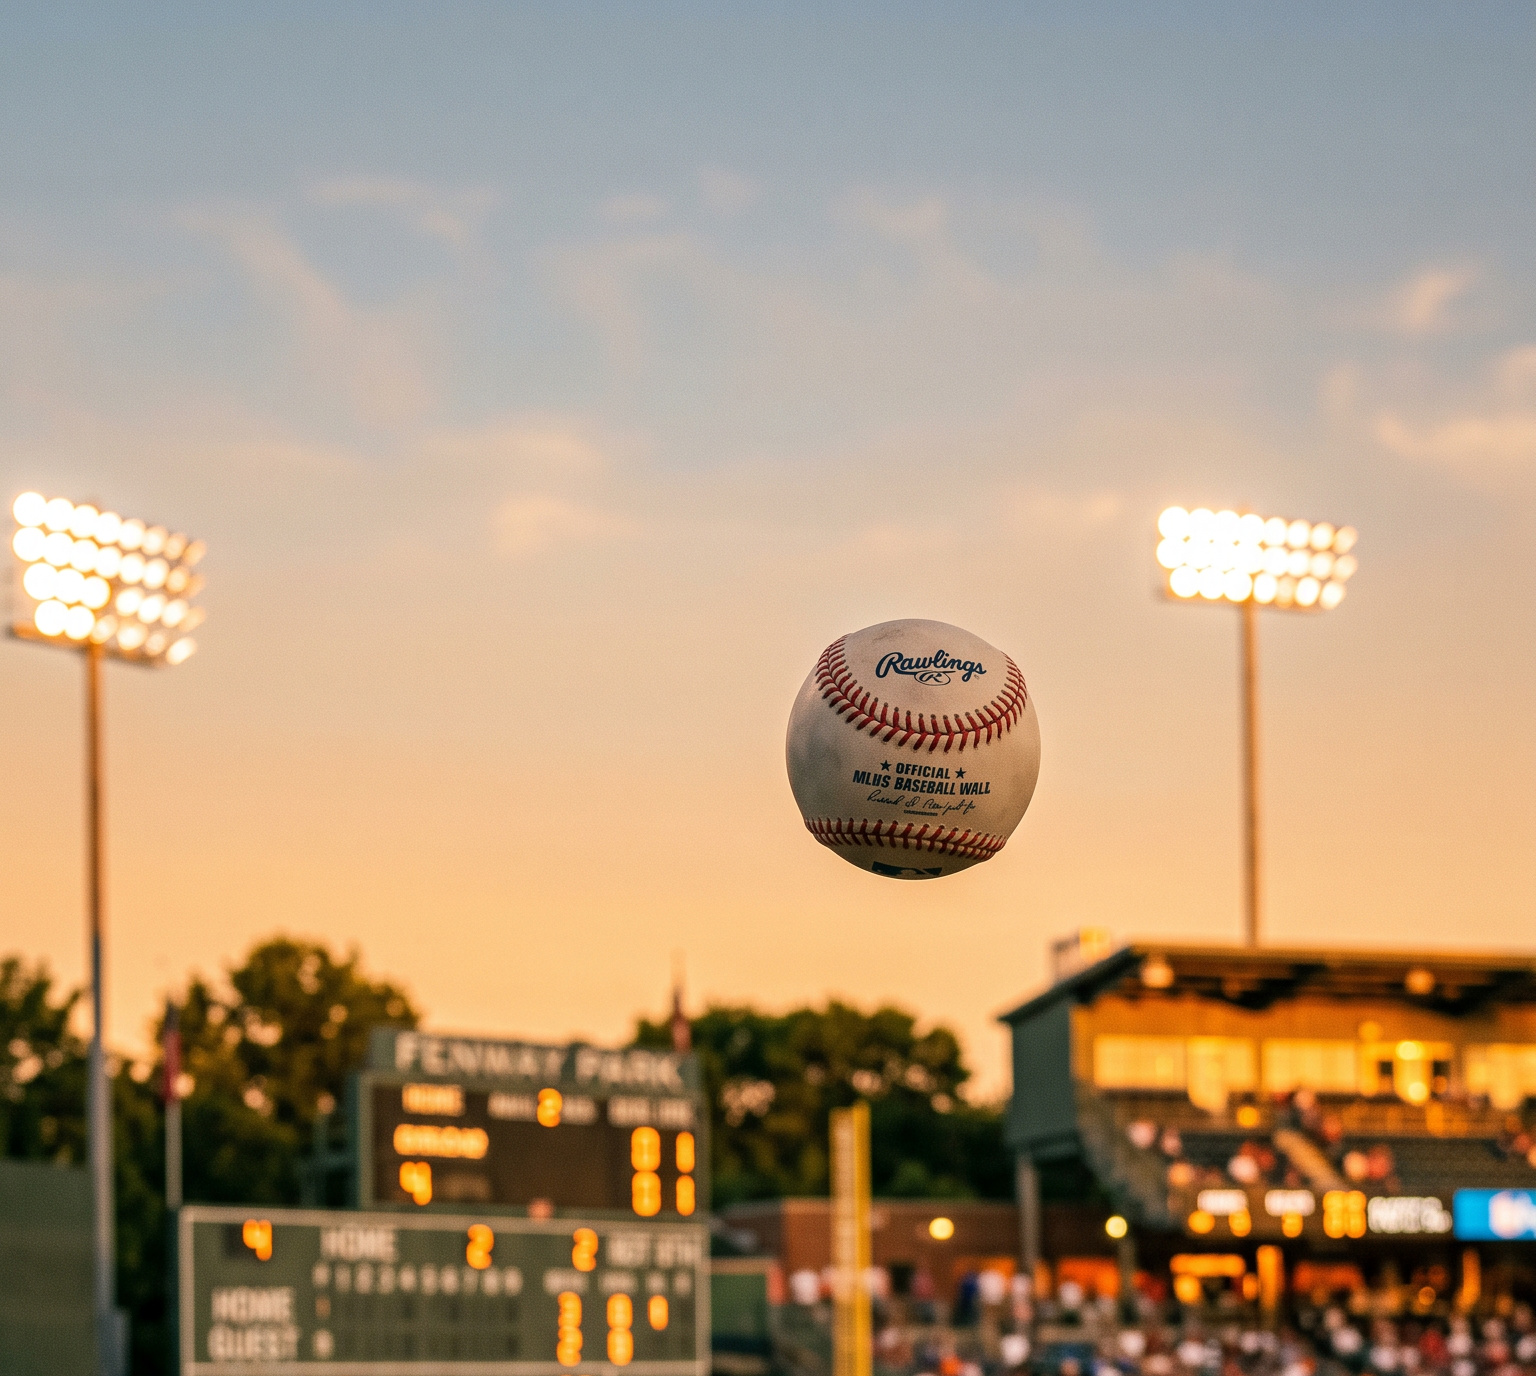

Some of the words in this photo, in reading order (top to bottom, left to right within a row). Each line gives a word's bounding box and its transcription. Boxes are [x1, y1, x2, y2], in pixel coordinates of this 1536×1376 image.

[875, 649, 987, 682] Rawlings
[894, 776, 956, 796] BASEBALL
[959, 781, 991, 796] WALL
[895, 762, 951, 779] OFFICIAL
[396, 1033, 565, 1078] FENWAY
[574, 1048, 683, 1090] PARK
[212, 1286, 294, 1322] HOME
